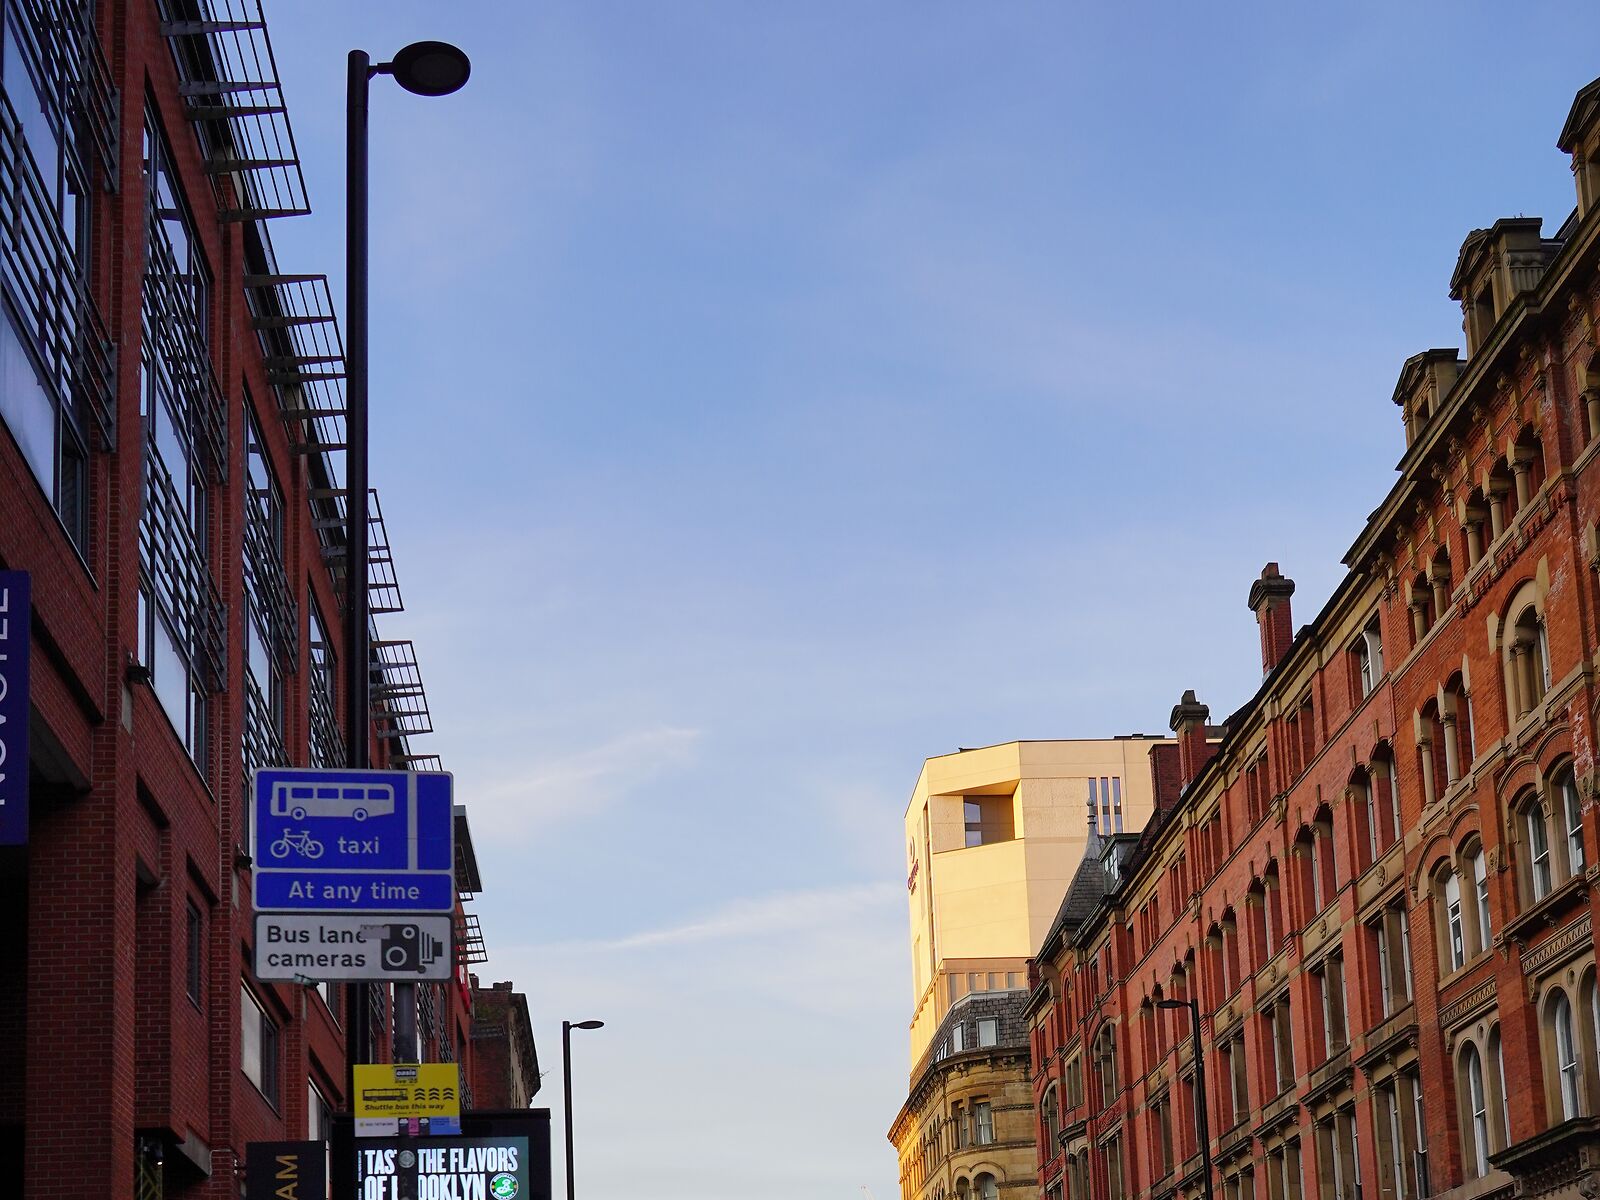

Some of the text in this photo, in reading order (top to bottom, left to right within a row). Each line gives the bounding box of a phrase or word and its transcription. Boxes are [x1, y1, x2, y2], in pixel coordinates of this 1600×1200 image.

[338, 837, 380, 854] taxi
[289, 880, 420, 902] At any time
[267, 925, 309, 943] Bus
[267, 953, 366, 967] cameras
[364, 1149, 397, 1175] TAS
[417, 1148, 446, 1173] THE
[450, 1147, 518, 1173] FLAVORS
